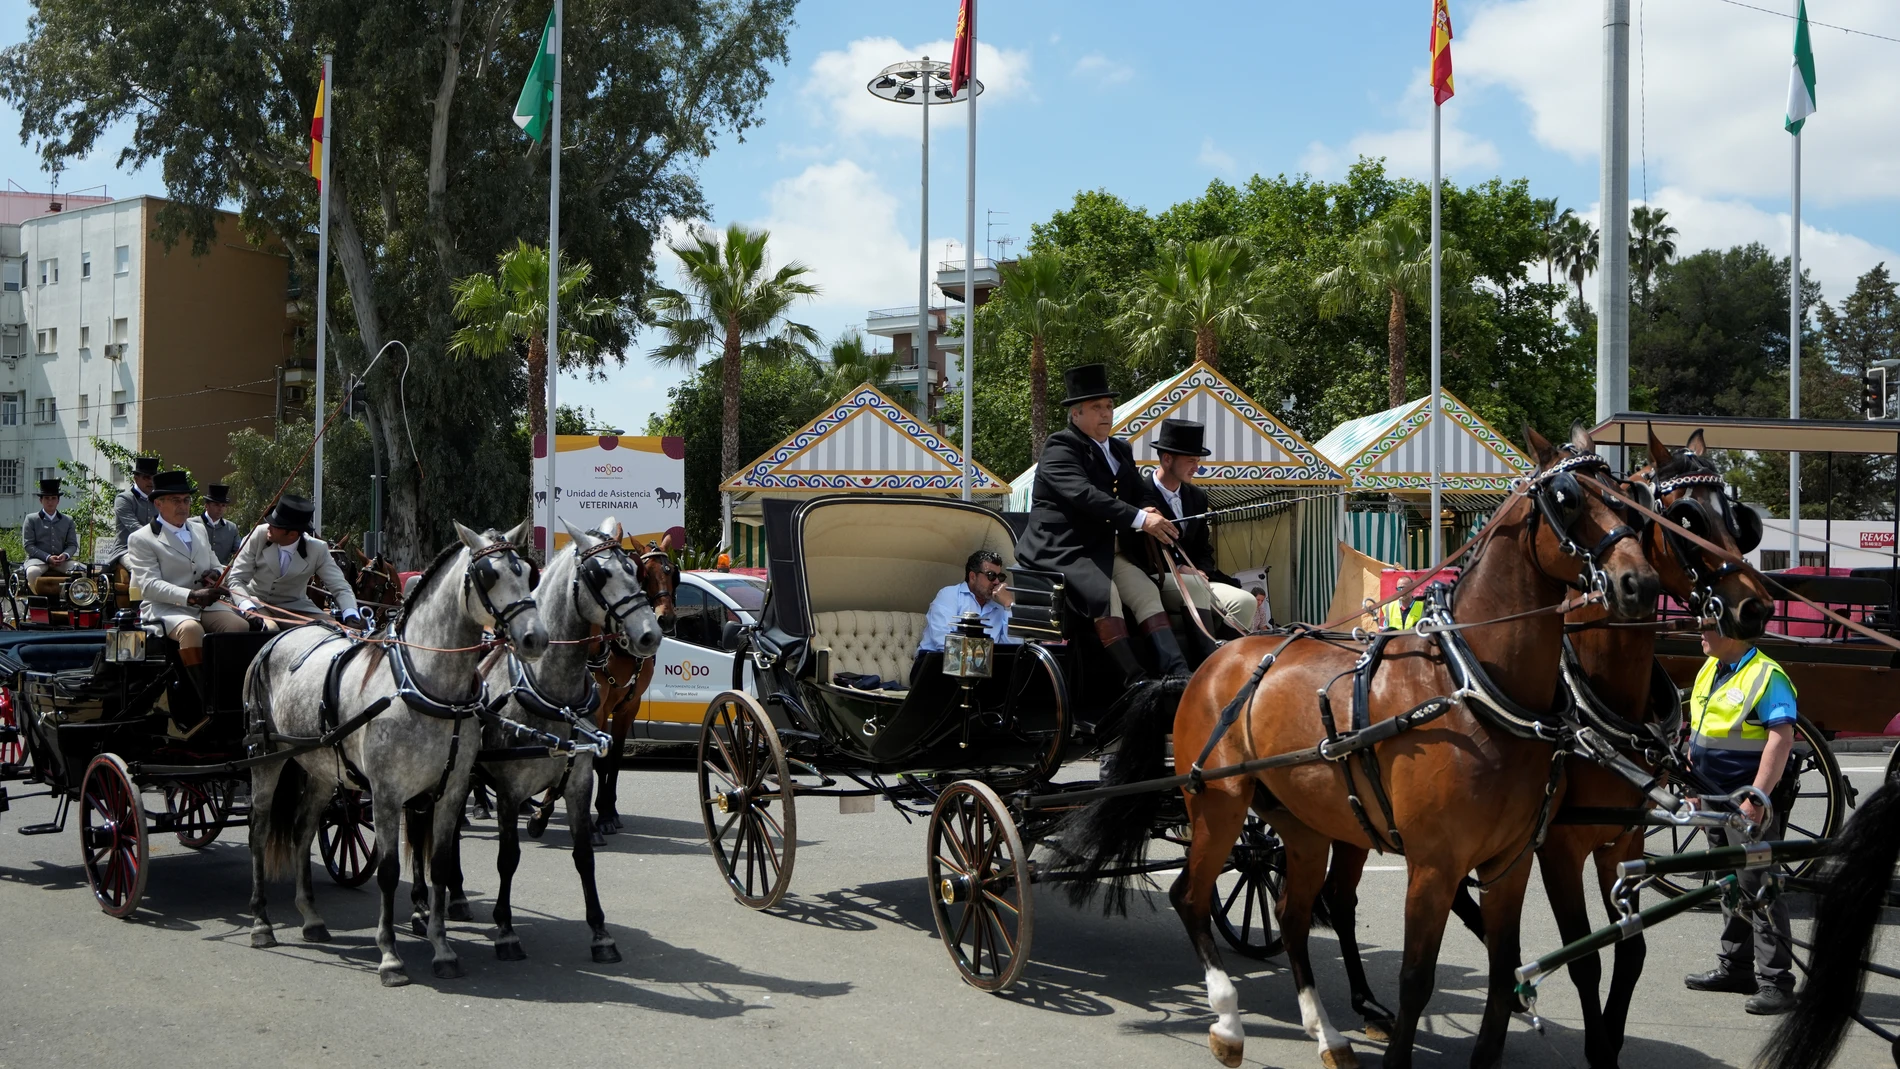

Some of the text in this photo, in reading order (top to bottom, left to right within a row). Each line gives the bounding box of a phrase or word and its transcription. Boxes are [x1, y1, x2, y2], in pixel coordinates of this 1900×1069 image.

[566, 489, 651, 498] Unidad de Asistencia
[579, 501, 638, 509] VETERINARIA
